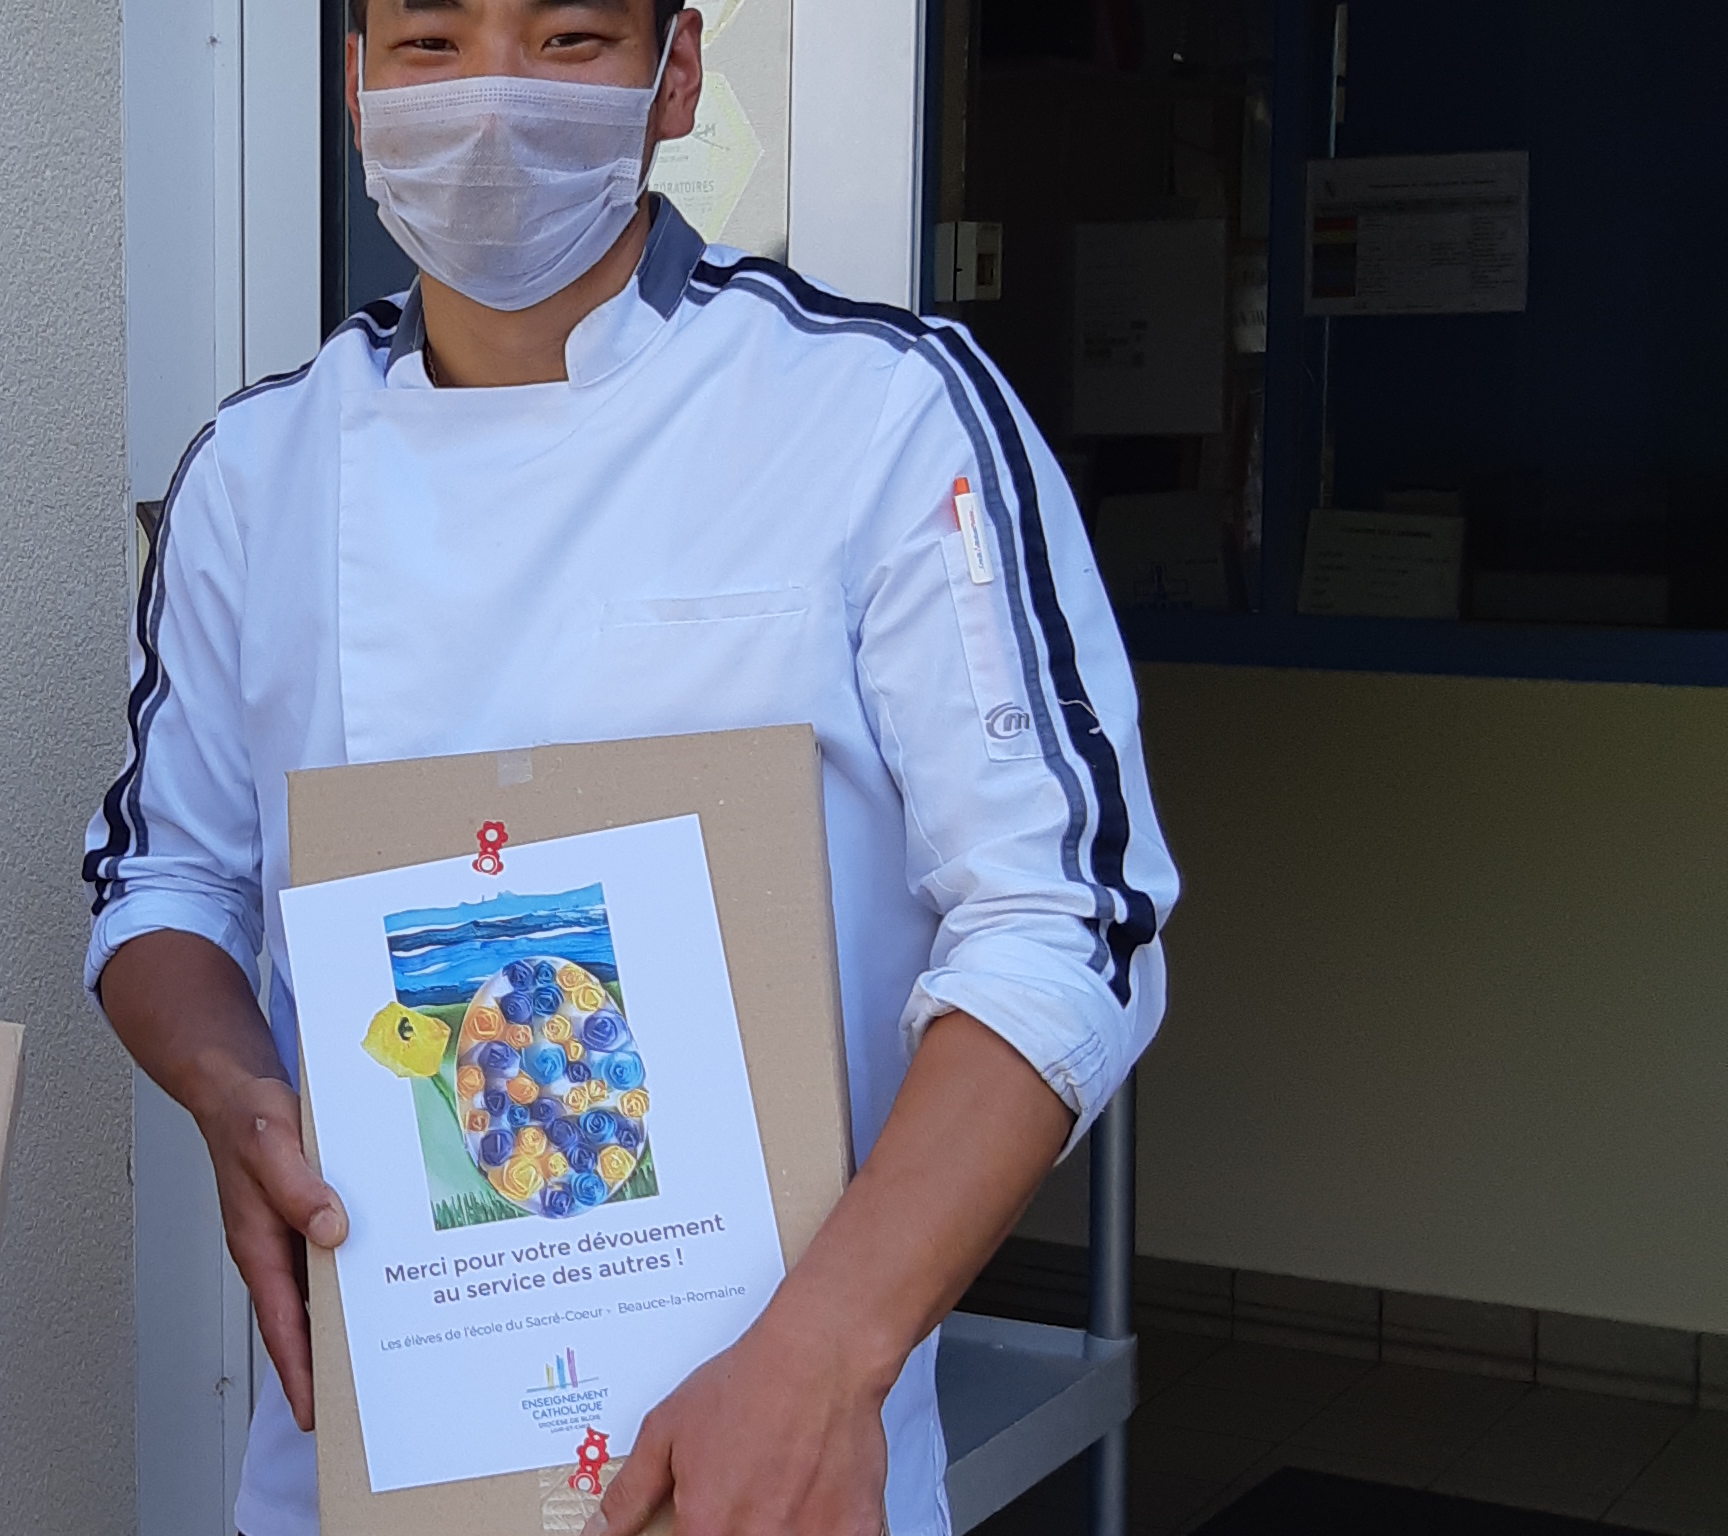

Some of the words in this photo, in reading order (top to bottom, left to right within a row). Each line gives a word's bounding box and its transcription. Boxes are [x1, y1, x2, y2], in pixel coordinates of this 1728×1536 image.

[385, 1256, 448, 1284] Merci
[454, 1250, 506, 1278] pour
[511, 1241, 571, 1264] votre
[577, 1214, 726, 1255] dévouement
[433, 1285, 460, 1305] au
[466, 1272, 546, 1299] service
[552, 1264, 593, 1286] des
[599, 1252, 671, 1278] autres
[676, 1248, 685, 1266] !
[380, 1338, 402, 1352] Les
[404, 1332, 443, 1349] élèves
[445, 1328, 461, 1341] de
[464, 1321, 503, 1338] l'école
[505, 1319, 524, 1332] du
[525, 1307, 604, 1328] Sacré-Coeur
[618, 1285, 747, 1314] Beauce-la-Romaine
[521, 1387, 609, 1410] ENSEIGNEMENT
[532, 1400, 603, 1420] CATHOLIQUE
